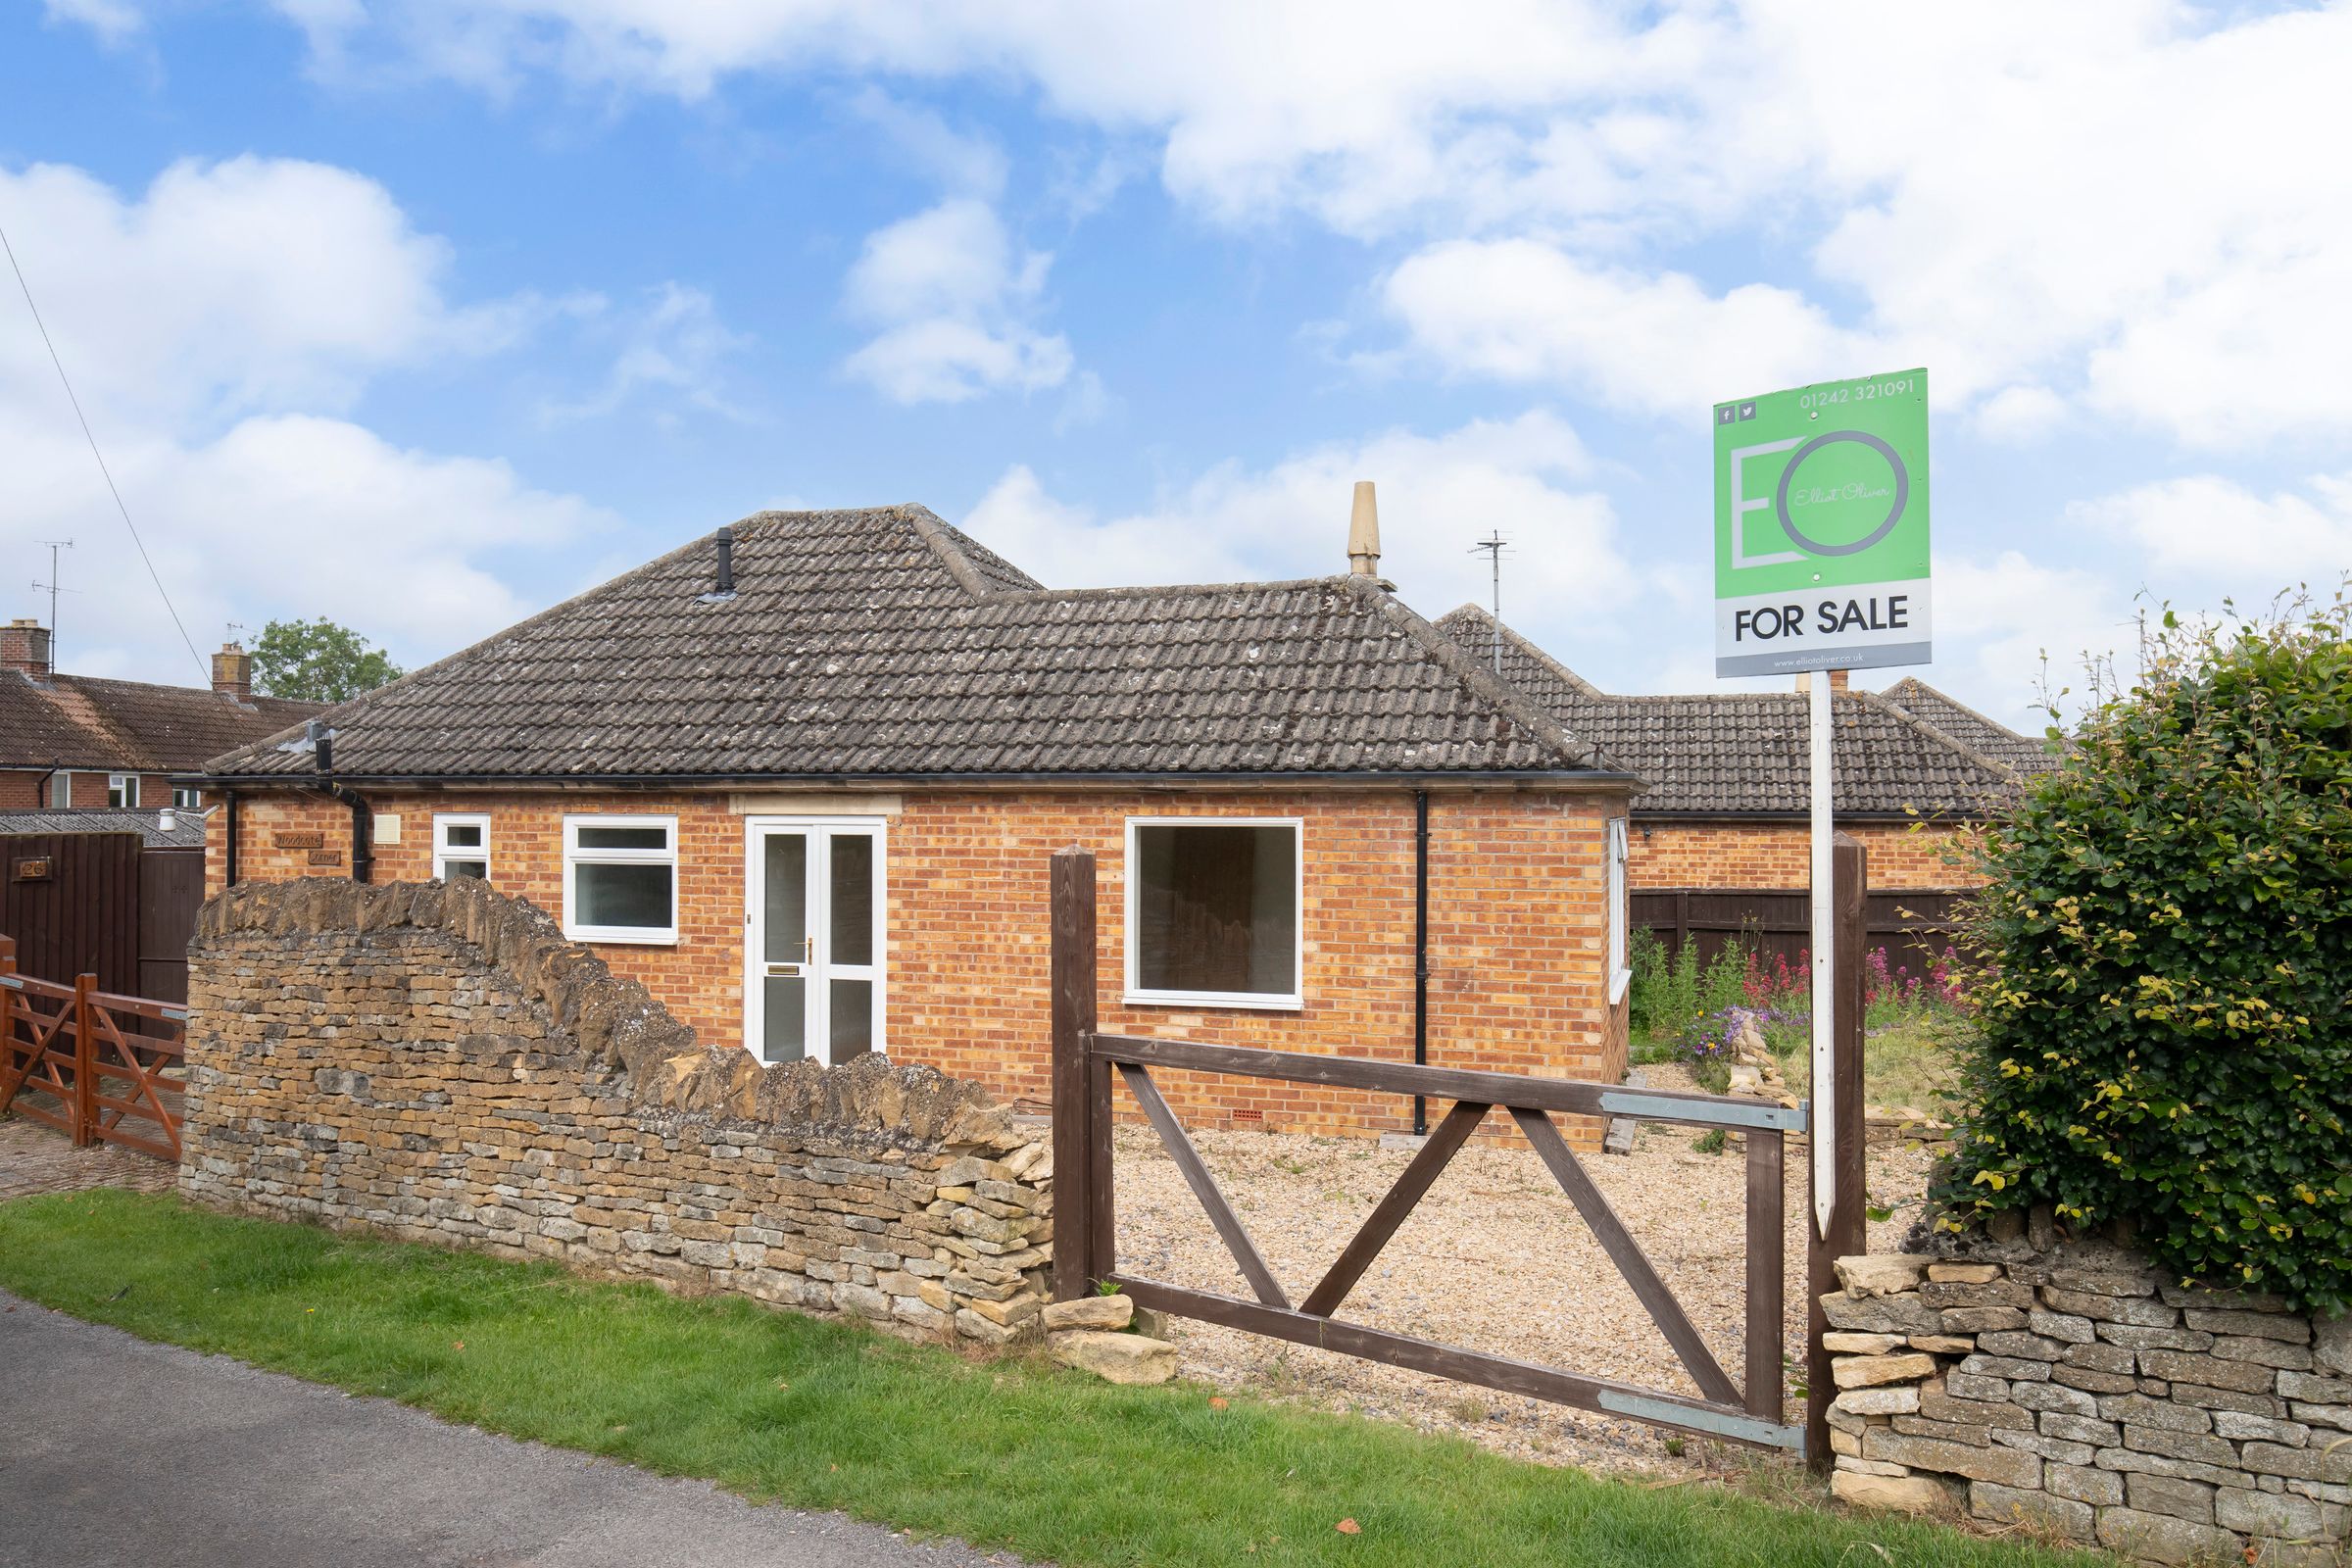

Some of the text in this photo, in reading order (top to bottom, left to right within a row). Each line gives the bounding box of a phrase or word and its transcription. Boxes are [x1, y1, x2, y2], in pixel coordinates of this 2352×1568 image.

[1799, 379, 1914, 409] 01242 321091
[1794, 482, 1889, 507] Elliot Oliver
[1735, 595, 1908, 642] FOR SALE
[1774, 653, 1864, 667] www.elliotoliver.co.uk
